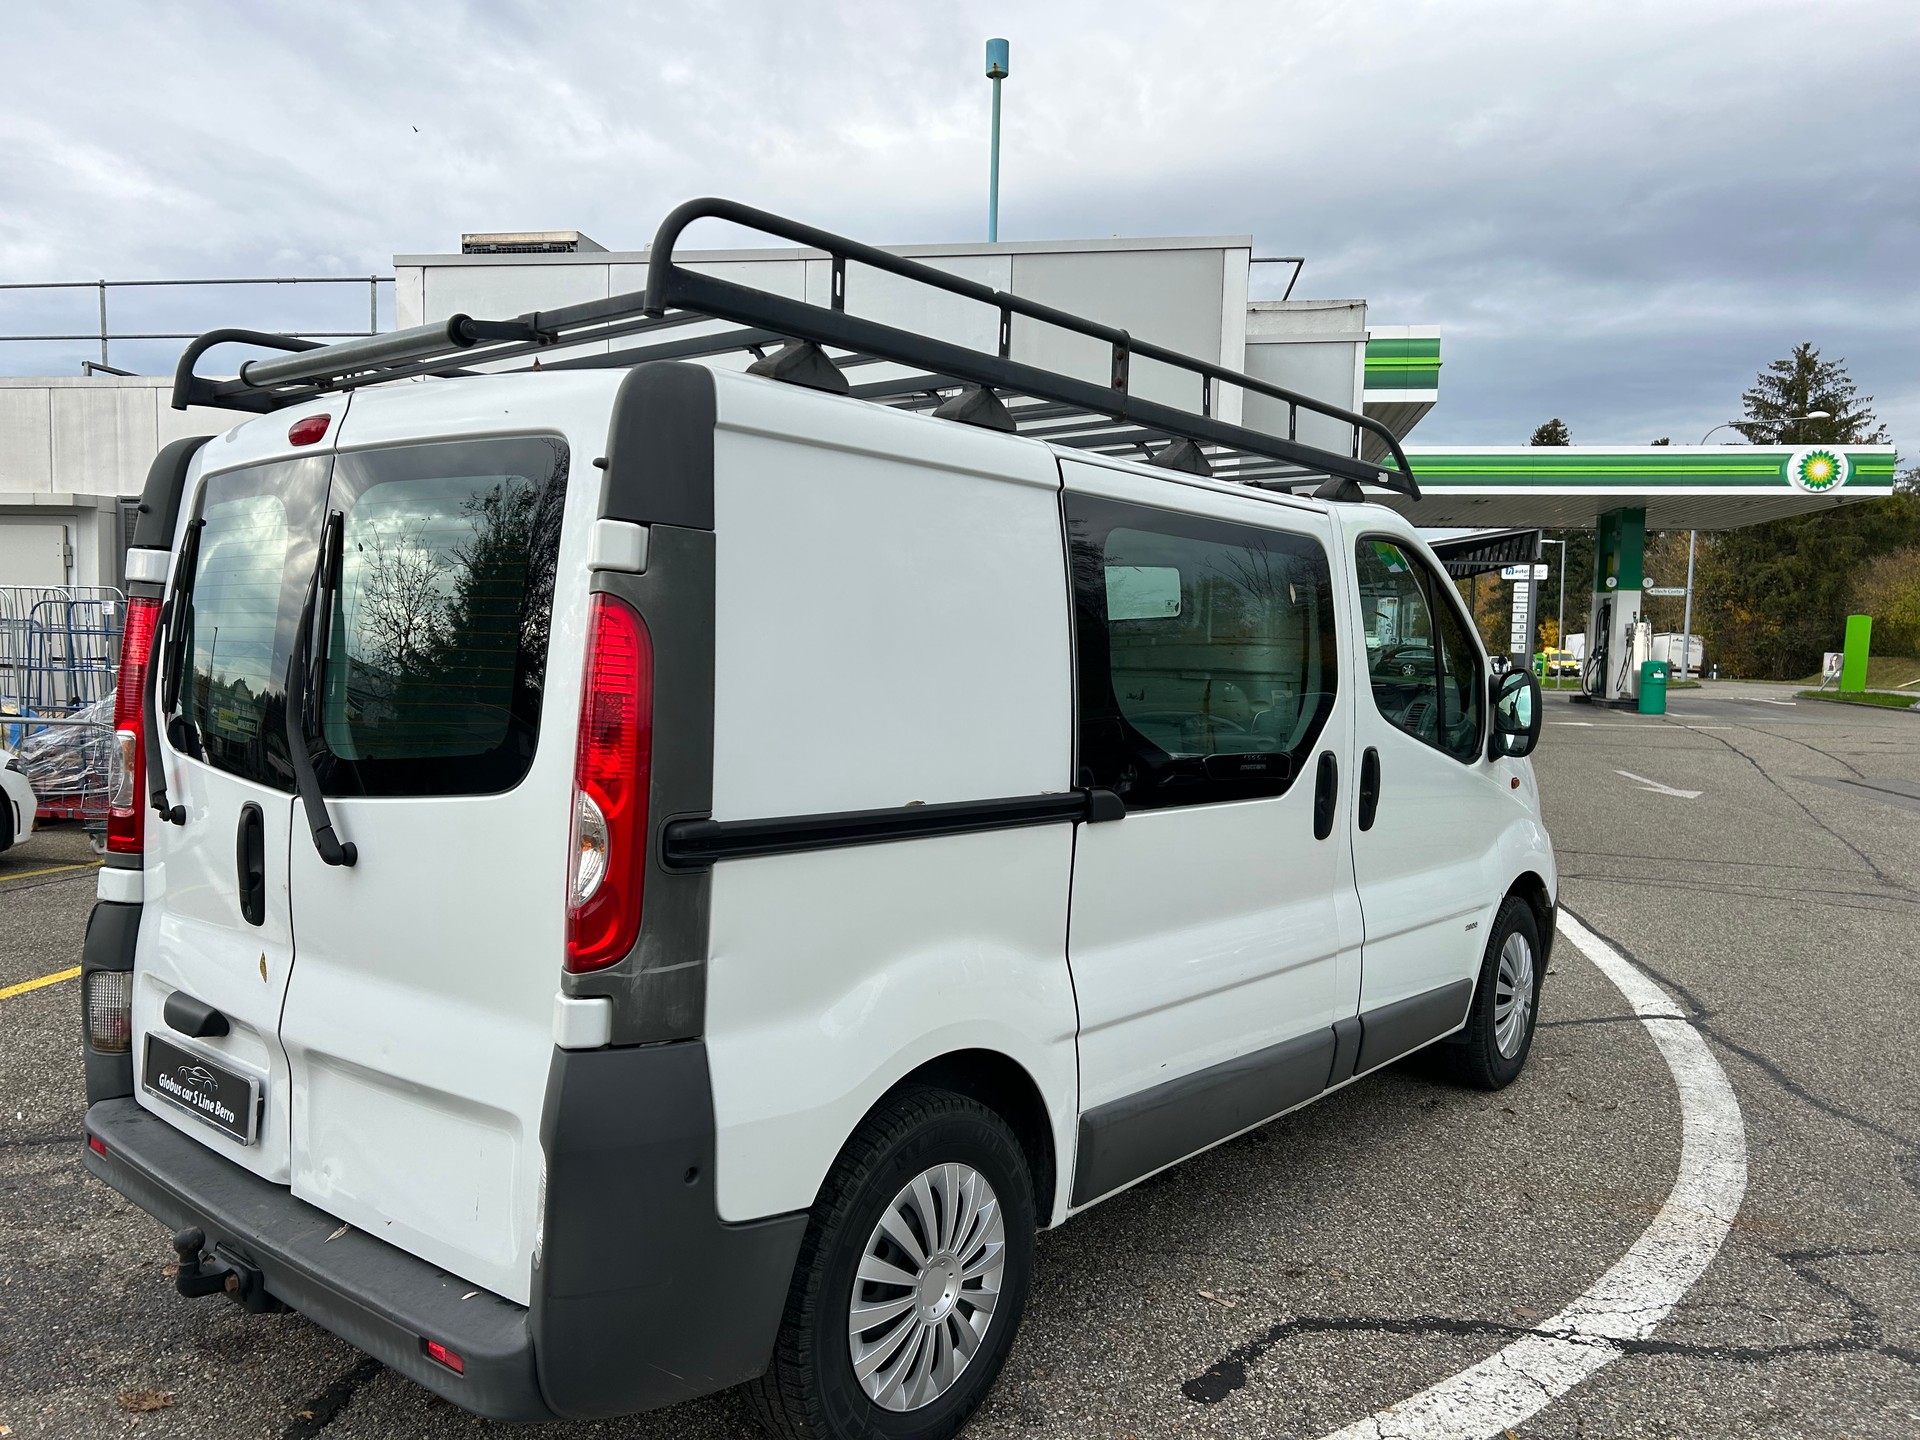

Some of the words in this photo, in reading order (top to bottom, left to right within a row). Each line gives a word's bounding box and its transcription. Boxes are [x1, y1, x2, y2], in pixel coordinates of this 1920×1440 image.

[158, 1073, 182, 1096] Globus
[181, 1086, 194, 1102] car
[193, 1090, 198, 1105] S
[197, 1093, 214, 1113] Line
[215, 1101, 235, 1123] Berro
